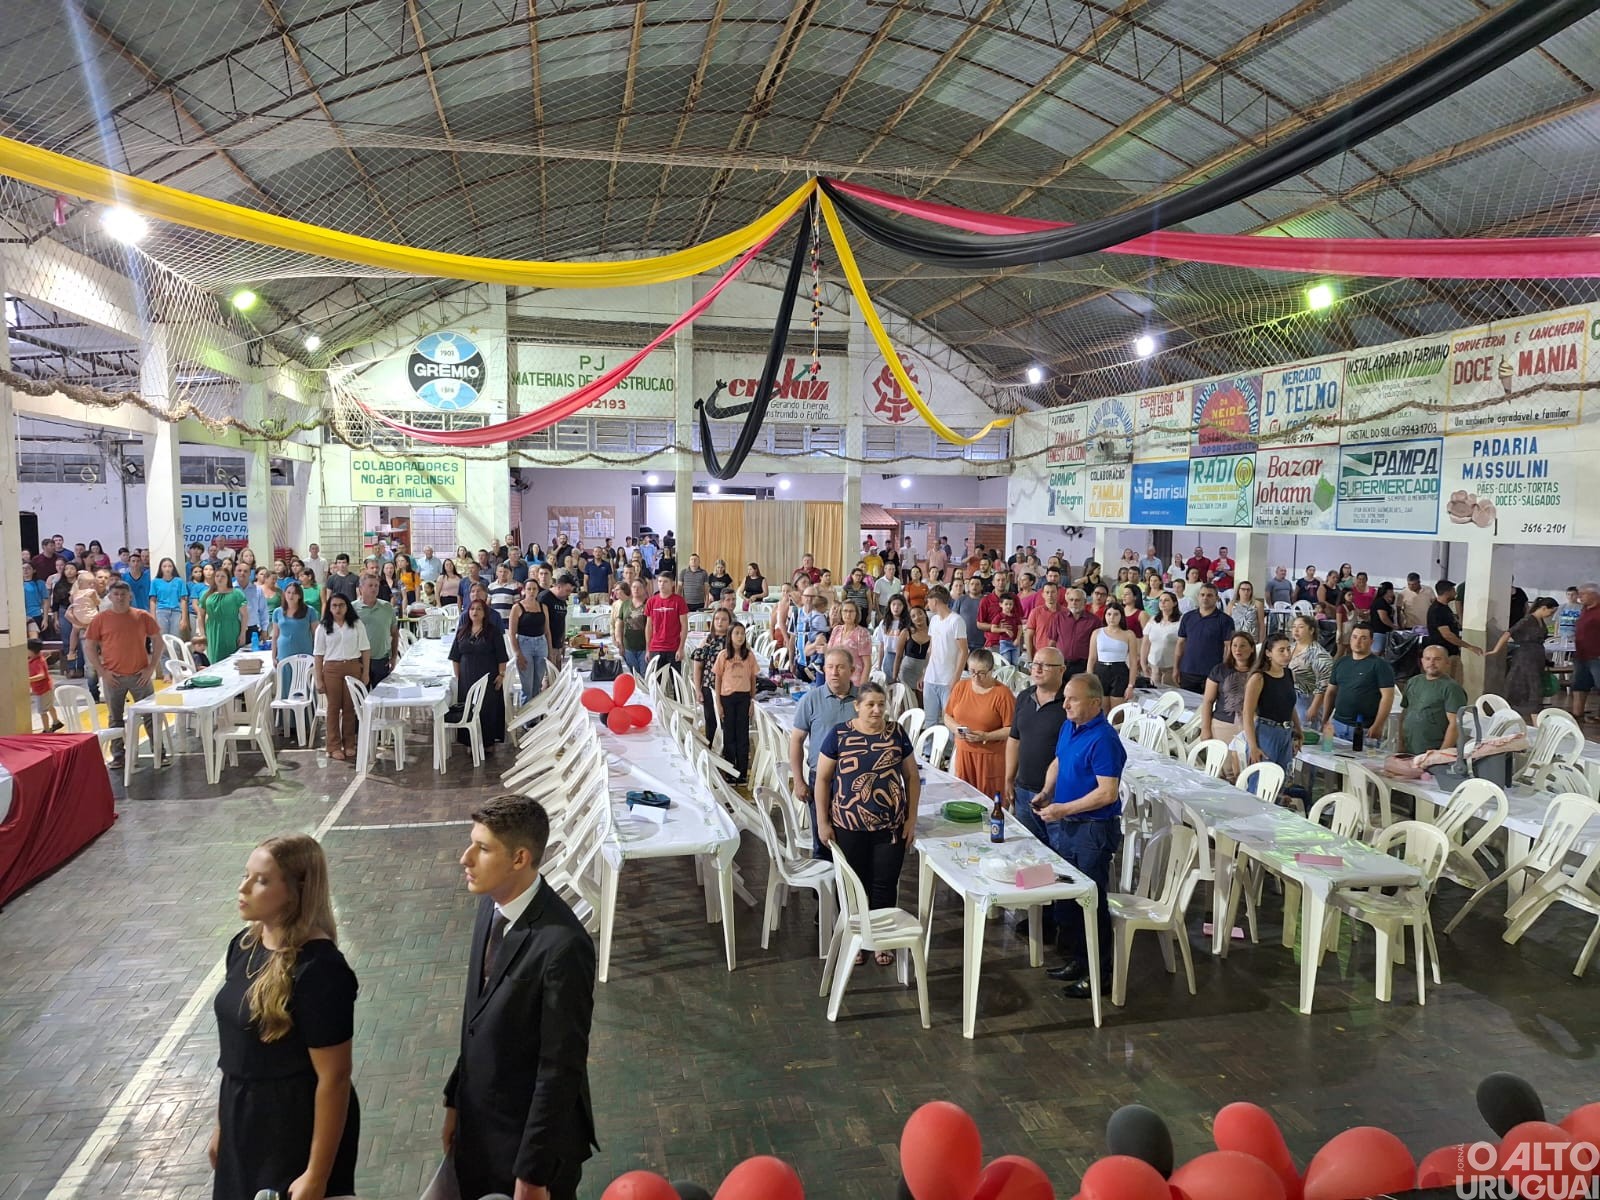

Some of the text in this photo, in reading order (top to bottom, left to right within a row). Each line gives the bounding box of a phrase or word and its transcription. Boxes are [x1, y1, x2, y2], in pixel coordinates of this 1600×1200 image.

[1453, 320, 1585, 353] SORVETERIA E LANCHERIA
[1346, 353, 1401, 374] INSTALADORA
[1402, 350, 1413, 367] DO
[1453, 343, 1577, 385] DOCE MANIA
[511, 371, 575, 388] MATERIAIS
[1285, 381, 1338, 414] TELMO
[1149, 405, 1174, 418] CLEUSA
[1211, 405, 1244, 419] NEIDE
[1346, 429, 1369, 440] CRISTAL
[1370, 427, 1380, 438] DO
[1381, 427, 1391, 437] SUL
[1473, 437, 1538, 457] PADARIA
[353, 461, 459, 472] COLABORADORES
[1267, 455, 1324, 478] Bazar
[1371, 448, 1438, 476] PAMPA
[1462, 460, 1548, 480] MASSULINI
[1143, 476, 1188, 500] Banrisul
[1255, 481, 1312, 507] Johann
[1339, 478, 1438, 496] SUPERMERCADO
[195, 524, 248, 533] PROGETA
[1521, 523, 1566, 533] 3616-2101
